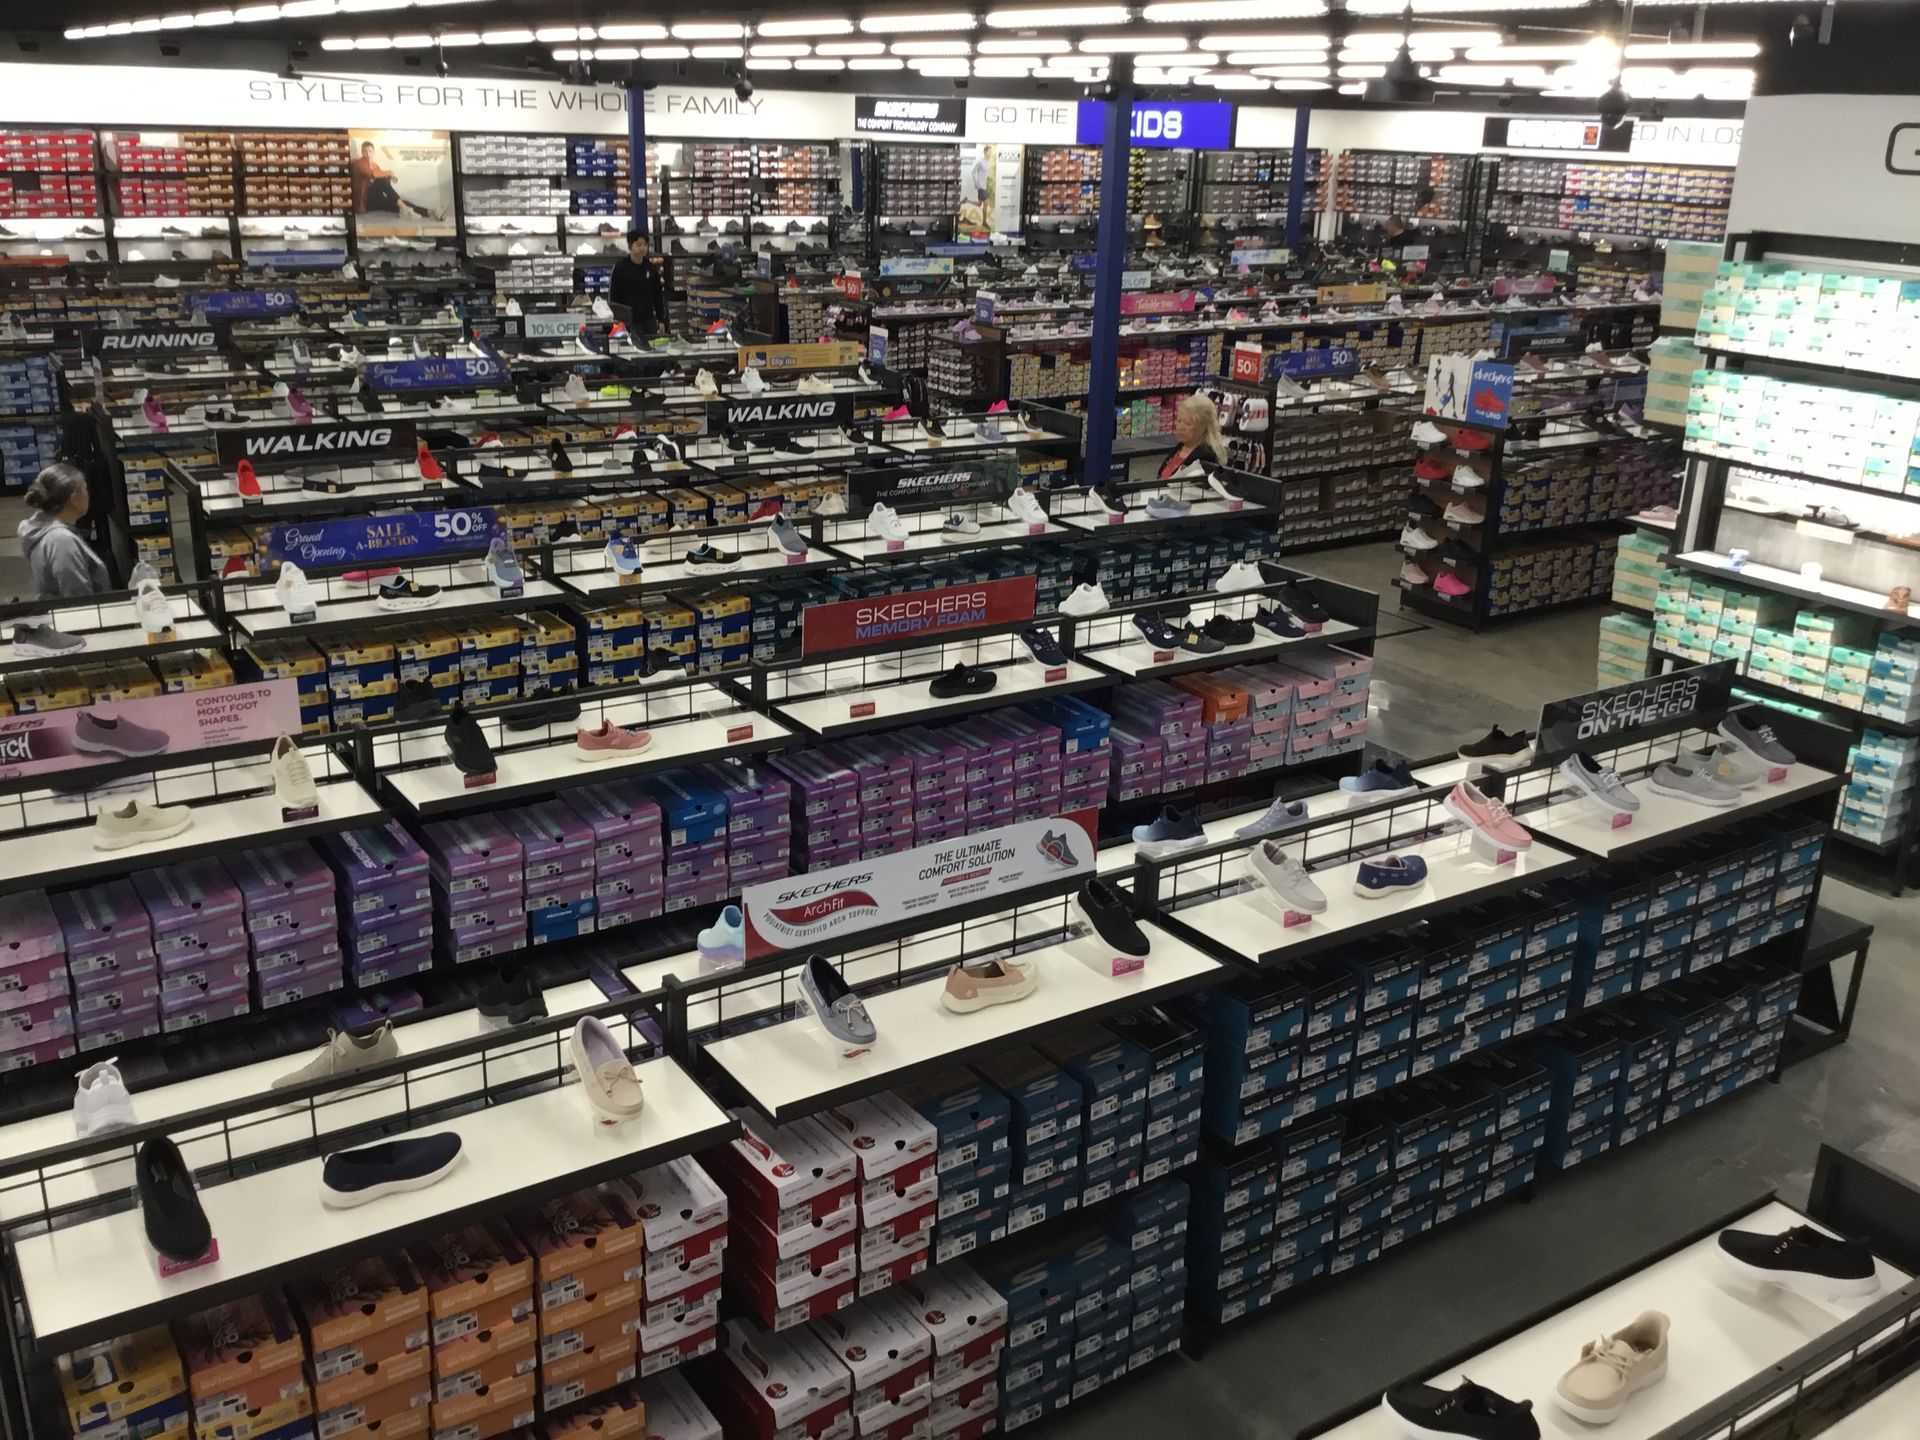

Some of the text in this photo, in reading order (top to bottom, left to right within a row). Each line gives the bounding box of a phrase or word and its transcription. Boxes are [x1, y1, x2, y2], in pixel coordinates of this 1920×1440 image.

[249, 80, 383, 104] STYLES
[398, 85, 464, 106] FOR
[476, 87, 537, 109] THE
[667, 94, 764, 115] FAMILY
[984, 106, 1068, 124] GO THE
[857, 118, 867, 129] THE
[929, 122, 957, 133] COMPANY
[1130, 110, 1183, 139] IDS
[1667, 126, 1691, 142] IN
[532, 323, 579, 336] 10% OFF
[102, 332, 215, 350] RUNNING
[1237, 359, 1252, 374] 50
[1331, 351, 1347, 366] 50
[466, 360, 489, 376] 50
[1474, 368, 1512, 386] skechers
[728, 401, 836, 424] WALKING
[246, 428, 392, 456] WALKING
[889, 487, 919, 497] COMFORT
[920, 483, 960, 493] TECHNOLOGY
[960, 480, 990, 489] COMPANY
[896, 472, 972, 489] SKECHERS
[366, 521, 406, 539] SALE
[434, 512, 483, 538] 50 %
[471, 522, 488, 532] OFF
[284, 528, 323, 551] Grand
[300, 545, 346, 562] Opening
[856, 591, 987, 626] SKECHERS
[855, 608, 986, 640] MEMORY FOAM
[195, 689, 272, 707] CONTOURS TO
[1581, 676, 1700, 722] SKECHERS
[196, 701, 259, 718] MOST FOOT
[198, 713, 242, 728] SHAPES.
[934, 838, 1002, 865] THE ULTIMATE
[919, 859, 966, 880] COMFORT
[968, 847, 1016, 869] SOLUTION
[776, 871, 873, 904] SKECHERS
[763, 908, 878, 937] PODIATRIST CERTIFIED ARCH SUPPORT
